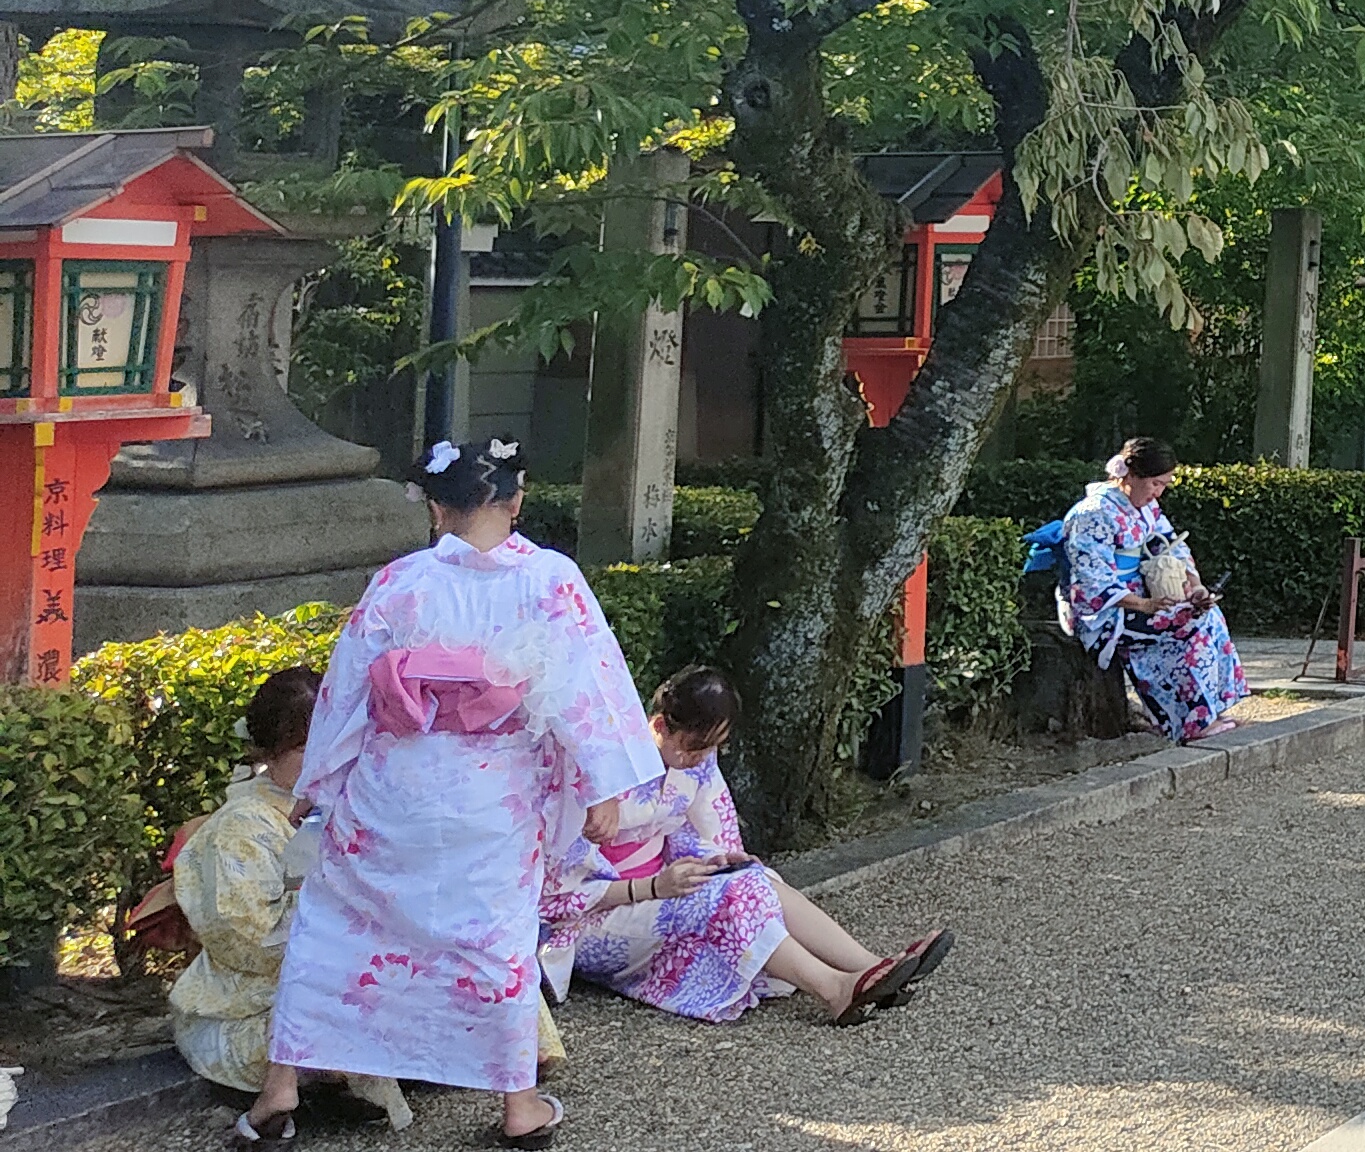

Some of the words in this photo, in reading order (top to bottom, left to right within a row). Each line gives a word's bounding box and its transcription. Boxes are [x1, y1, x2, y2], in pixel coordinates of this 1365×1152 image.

[90, 327, 109, 362] 献燈
[41, 477, 70, 572] 京料理
[35, 589, 69, 684] 美濃
